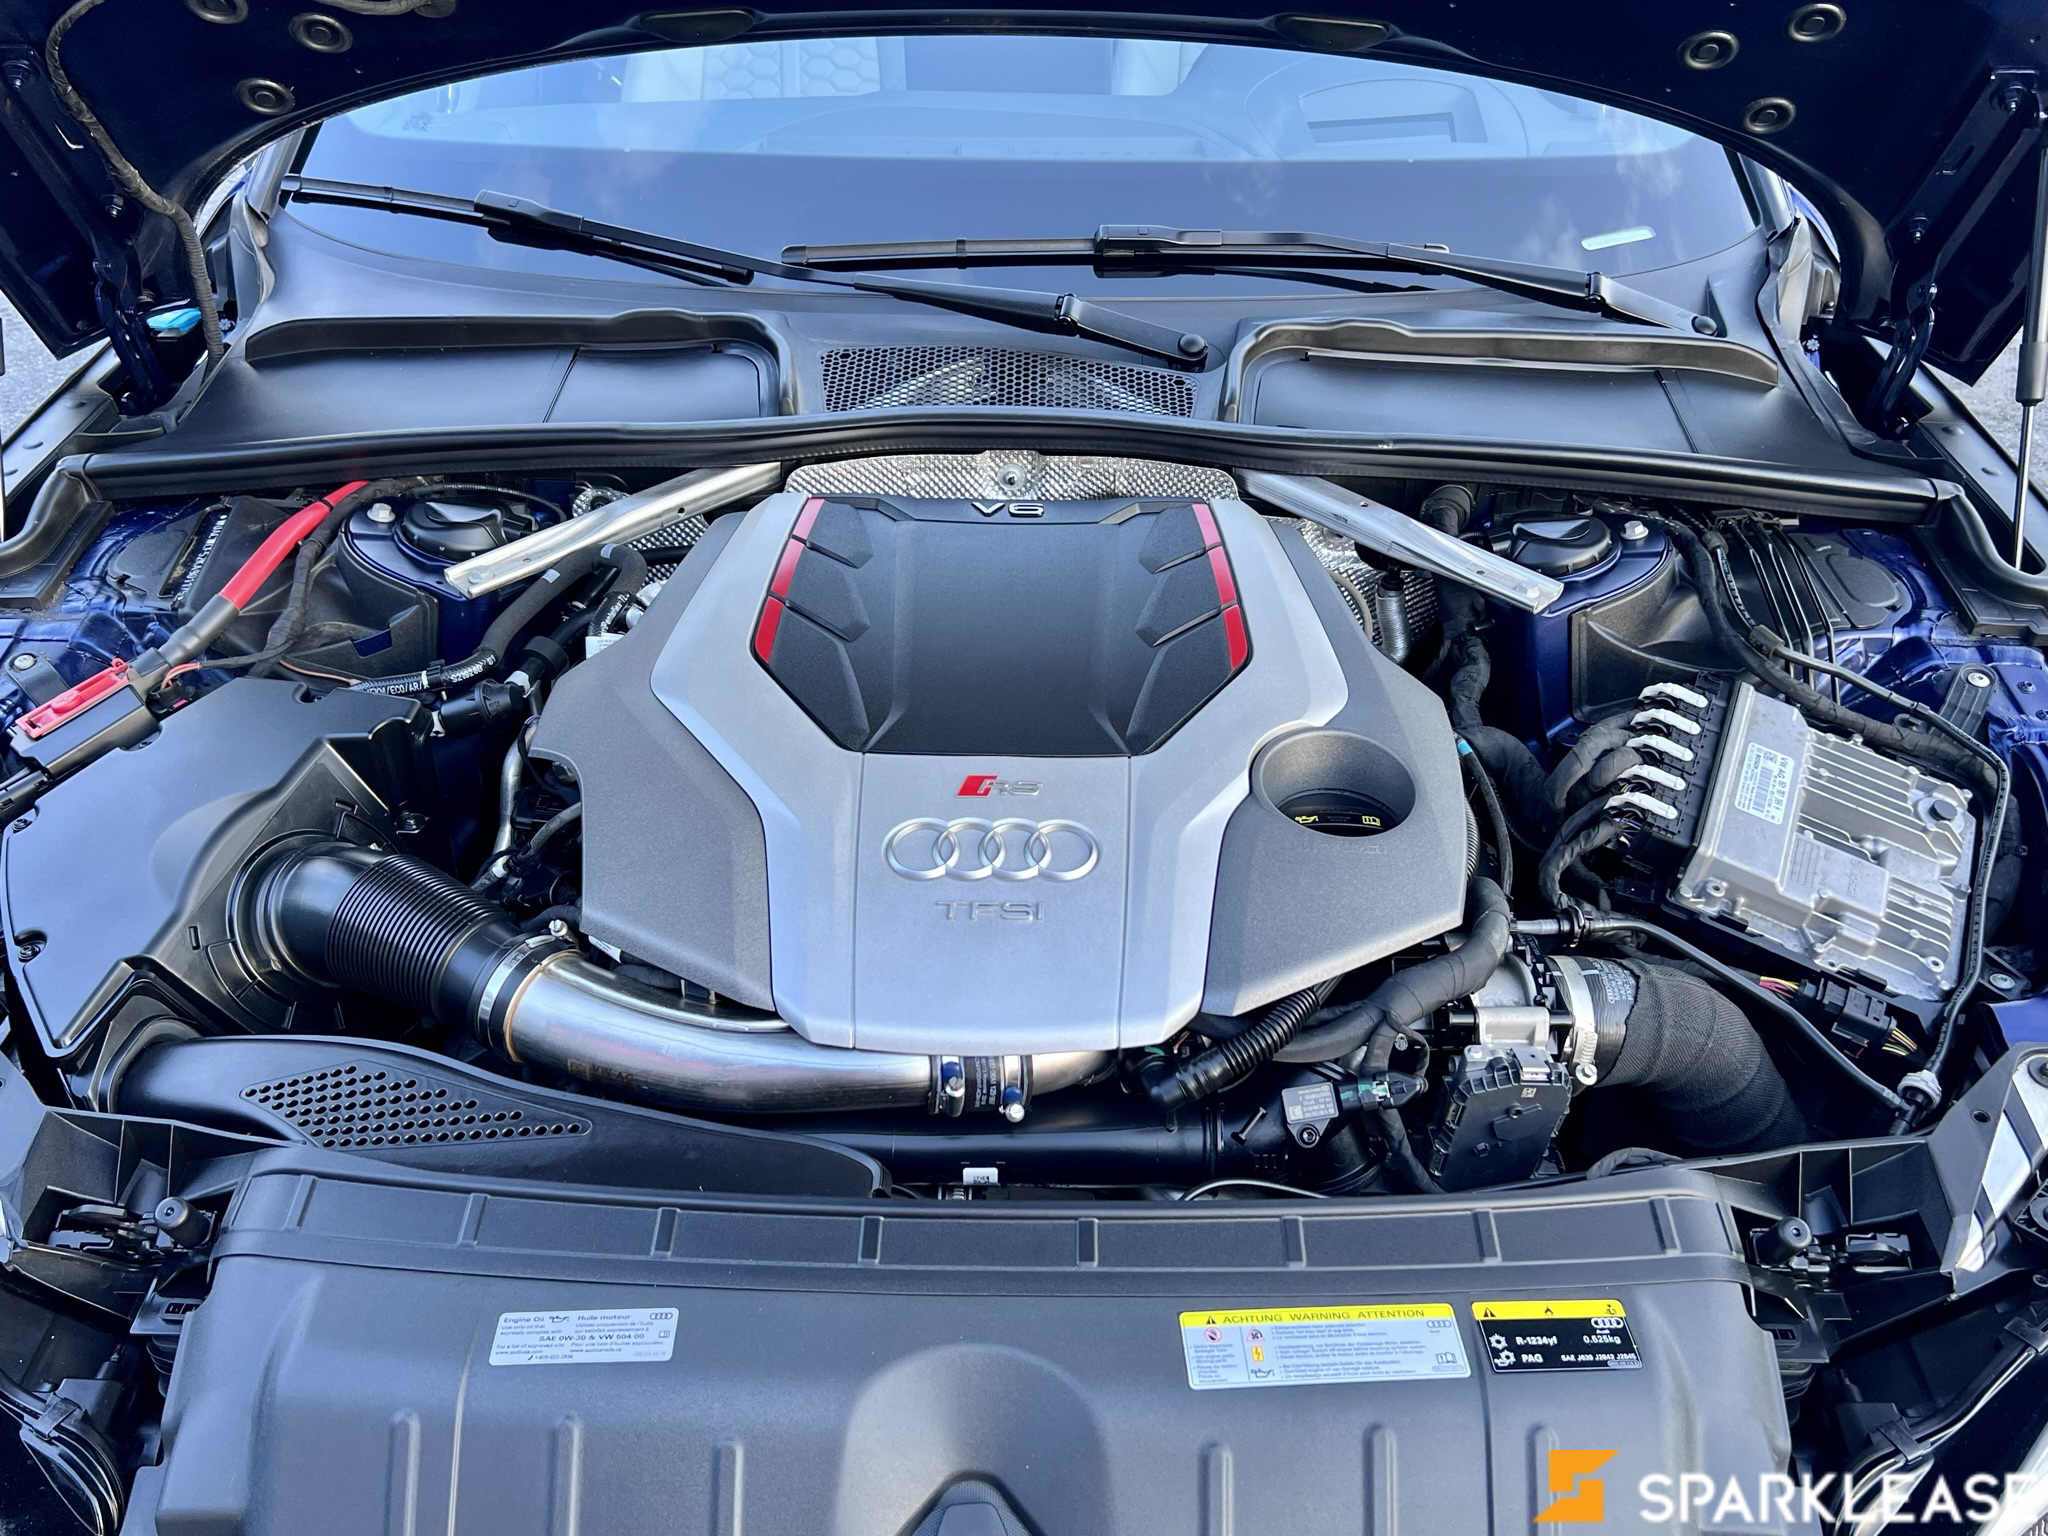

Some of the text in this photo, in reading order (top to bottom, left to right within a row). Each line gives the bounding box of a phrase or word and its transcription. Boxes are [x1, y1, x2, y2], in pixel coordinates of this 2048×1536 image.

[970, 501, 1045, 518] V6
[935, 901, 1043, 921] TFSI
[1223, 1309, 1425, 1324] ACHTUNG WARNING ATTENTION
[1516, 1335, 1558, 1347] R-1234yf
[1521, 1353, 1544, 1364] PAG
